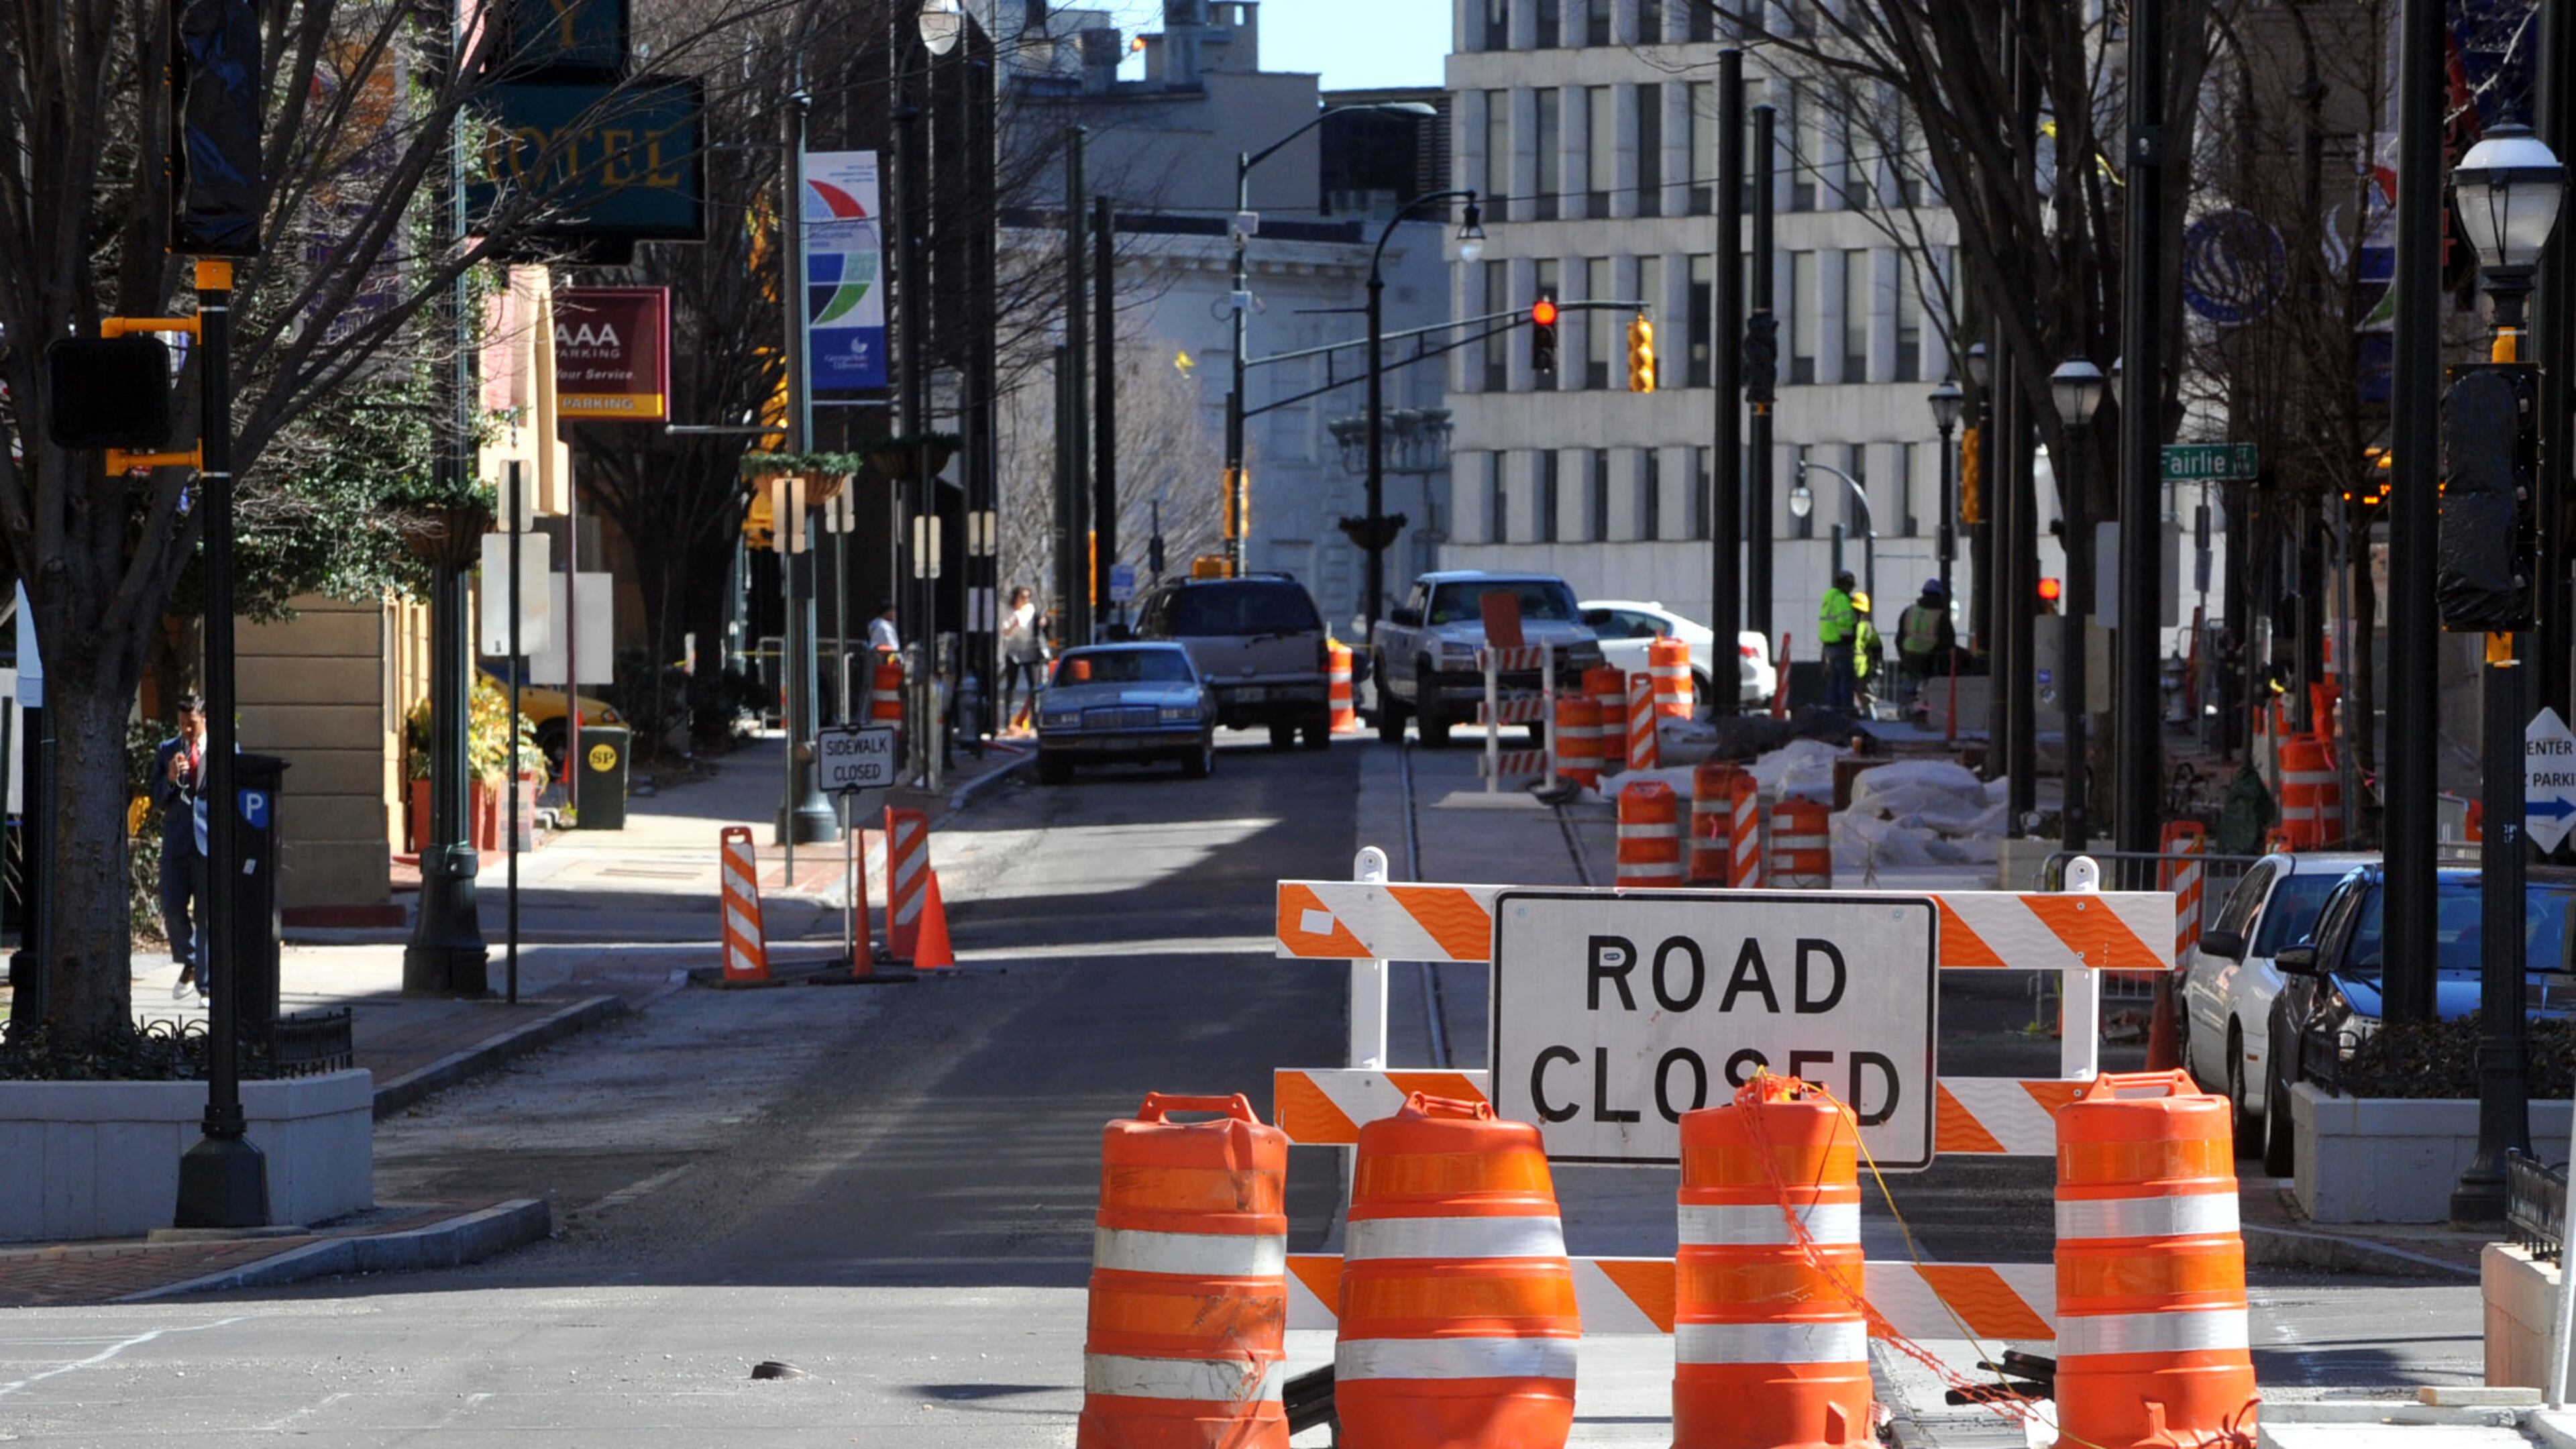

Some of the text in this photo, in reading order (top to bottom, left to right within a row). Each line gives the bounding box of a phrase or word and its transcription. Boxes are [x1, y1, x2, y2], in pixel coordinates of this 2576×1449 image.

[555, 323, 621, 347] AAA
[555, 349, 621, 358] ARKING
[562, 397, 634, 409] PARKING
[826, 737, 887, 757] SIDEWALK
[592, 751, 614, 765] SP
[834, 763, 881, 782] CLOSED
[246, 793, 264, 820] P
[1587, 935, 1847, 1014] ROAD
